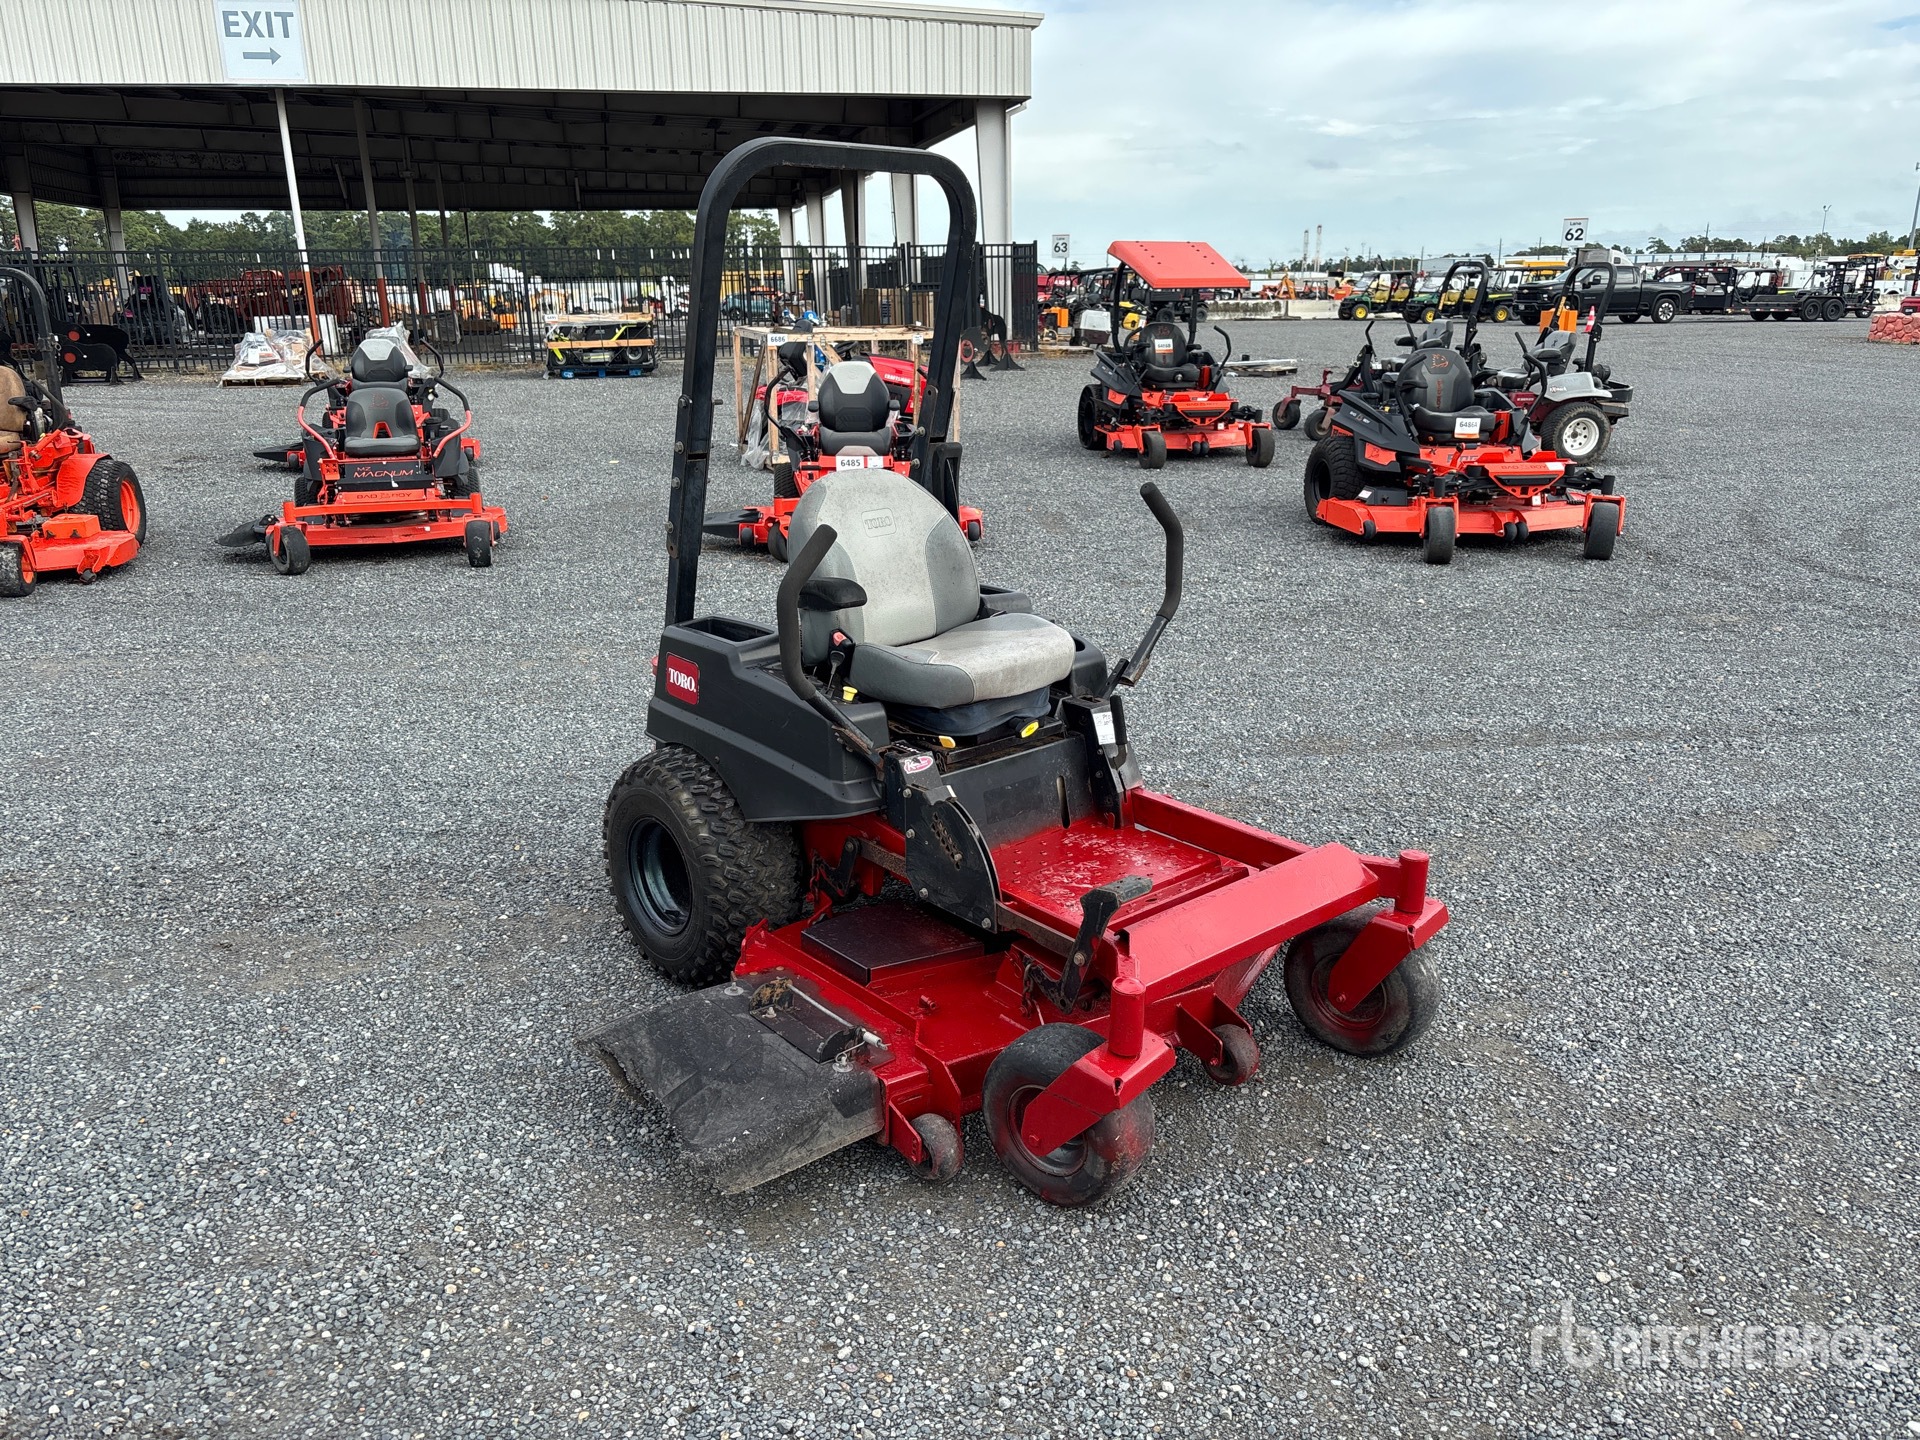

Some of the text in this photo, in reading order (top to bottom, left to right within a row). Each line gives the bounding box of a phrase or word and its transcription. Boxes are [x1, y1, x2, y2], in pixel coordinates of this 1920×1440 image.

[222, 10, 294, 38] EXIT
[1564, 227, 1584, 241] 62
[1053, 242, 1068, 253] 63
[1459, 420, 1478, 428] 6486A
[840, 459, 861, 467] 6485
[353, 469, 414, 478] MAGNUM
[864, 515, 892, 530] TORO
